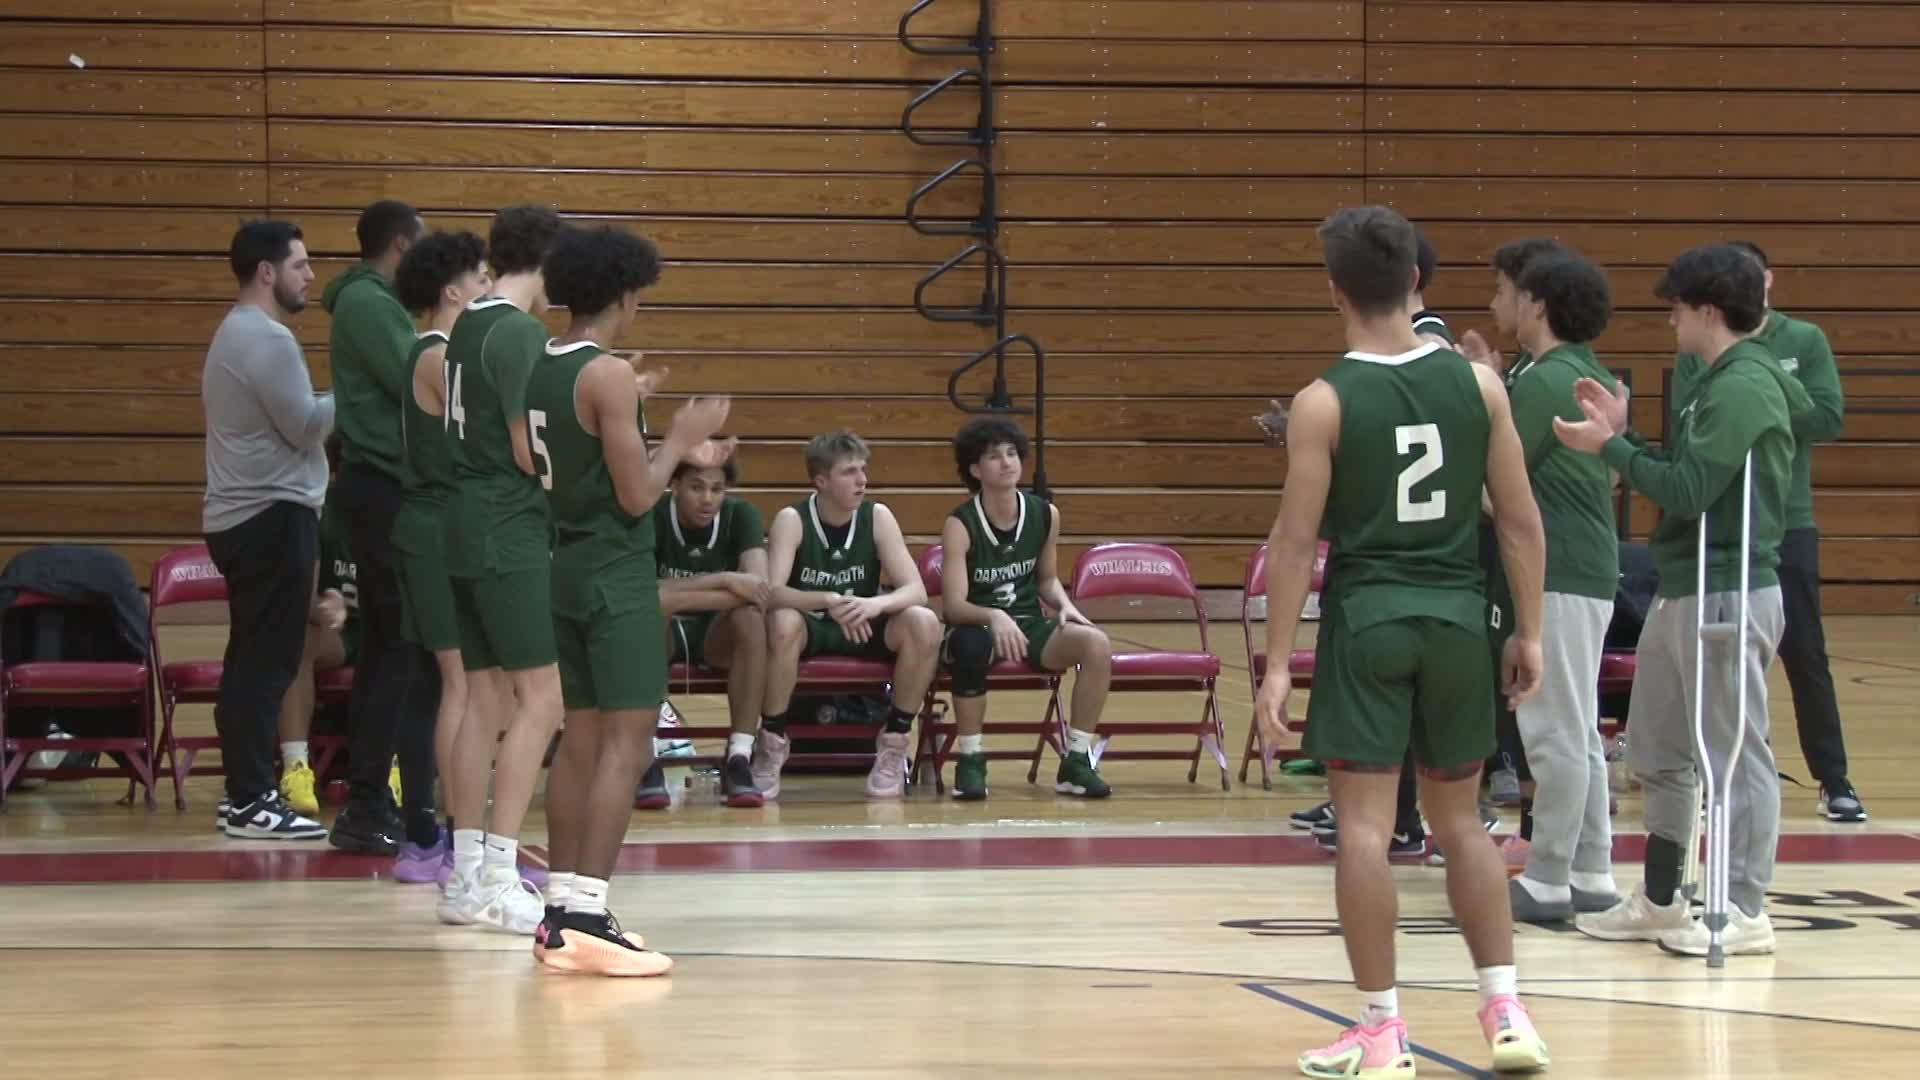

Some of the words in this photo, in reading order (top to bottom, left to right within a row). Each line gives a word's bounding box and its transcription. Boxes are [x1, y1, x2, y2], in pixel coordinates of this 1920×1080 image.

[443, 358, 466, 440] 14
[528, 408, 553, 491] 5
[1394, 423, 1447, 523] 2
[800, 564, 865, 587] DARTMOUTH
[1089, 559, 1174, 576] WHALERS
[991, 582, 1017, 608] 3
